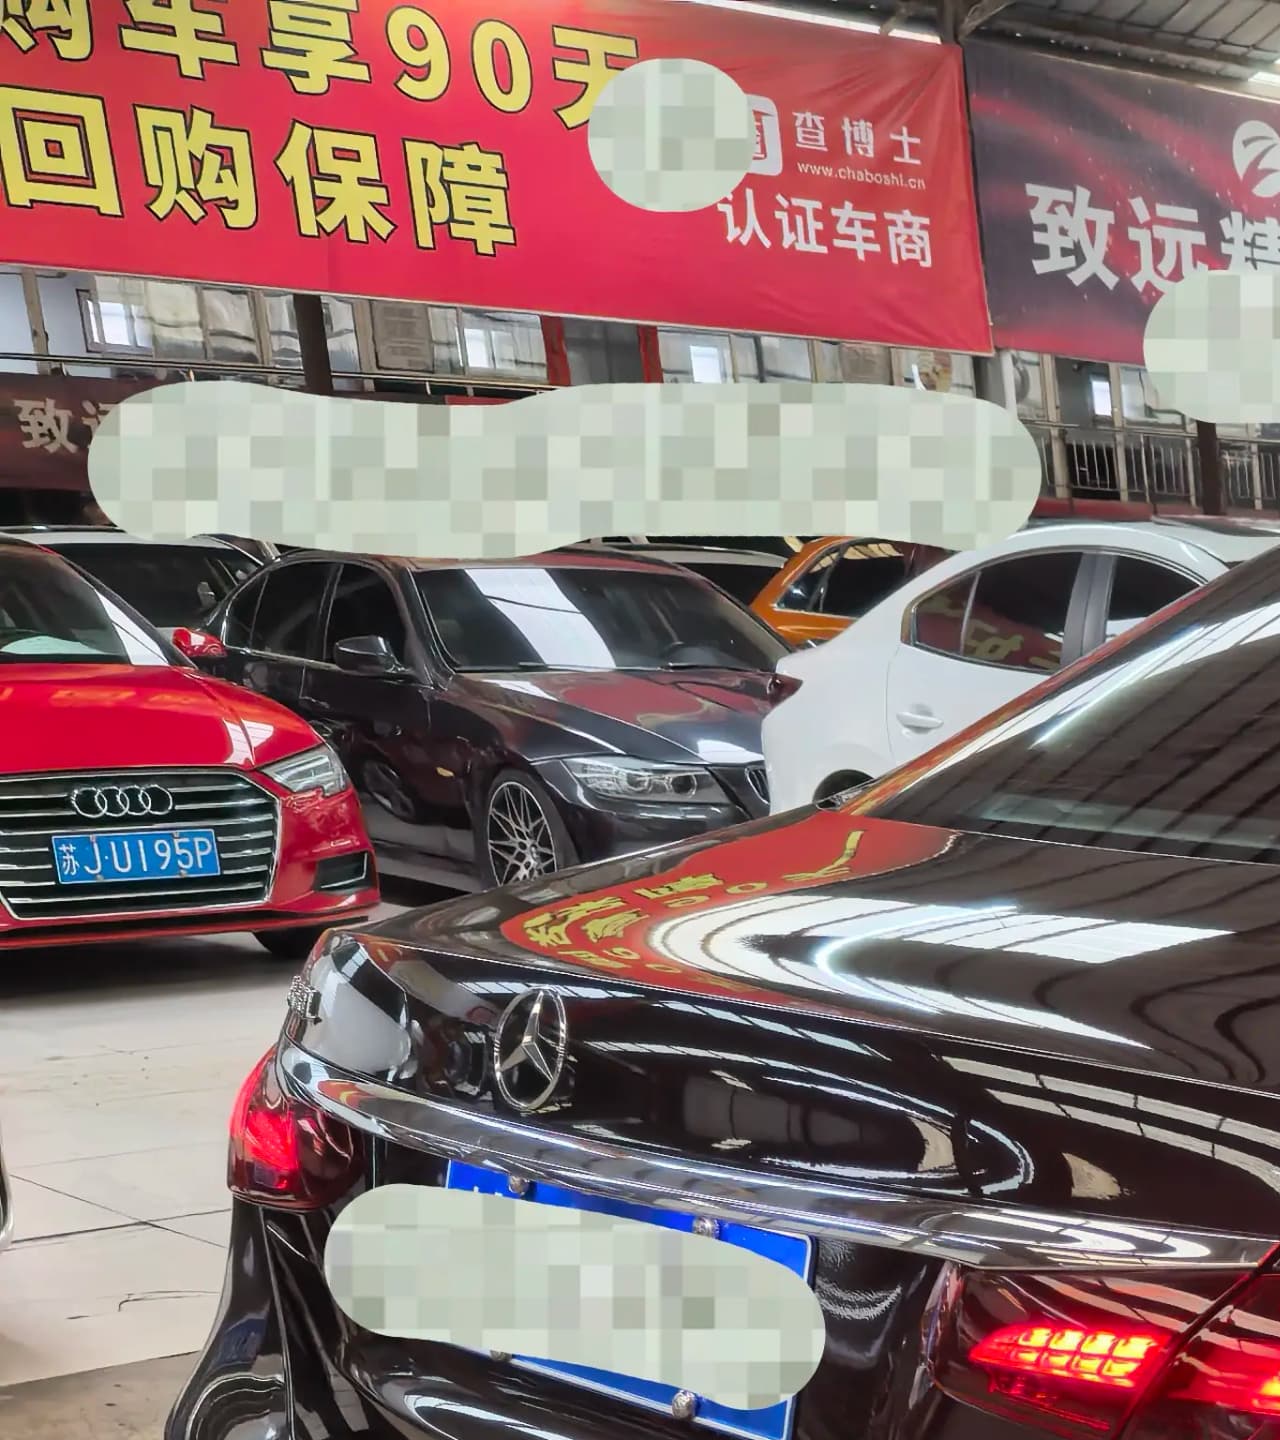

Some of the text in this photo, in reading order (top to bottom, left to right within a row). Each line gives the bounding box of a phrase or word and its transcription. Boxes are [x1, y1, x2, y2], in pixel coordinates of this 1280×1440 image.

[0, 84, 517, 257] 回购保障
[792, 111, 922, 165] 查博士
[797, 162, 926, 190] www.chaboshi.cn
[717, 189, 932, 268] 认证车商
